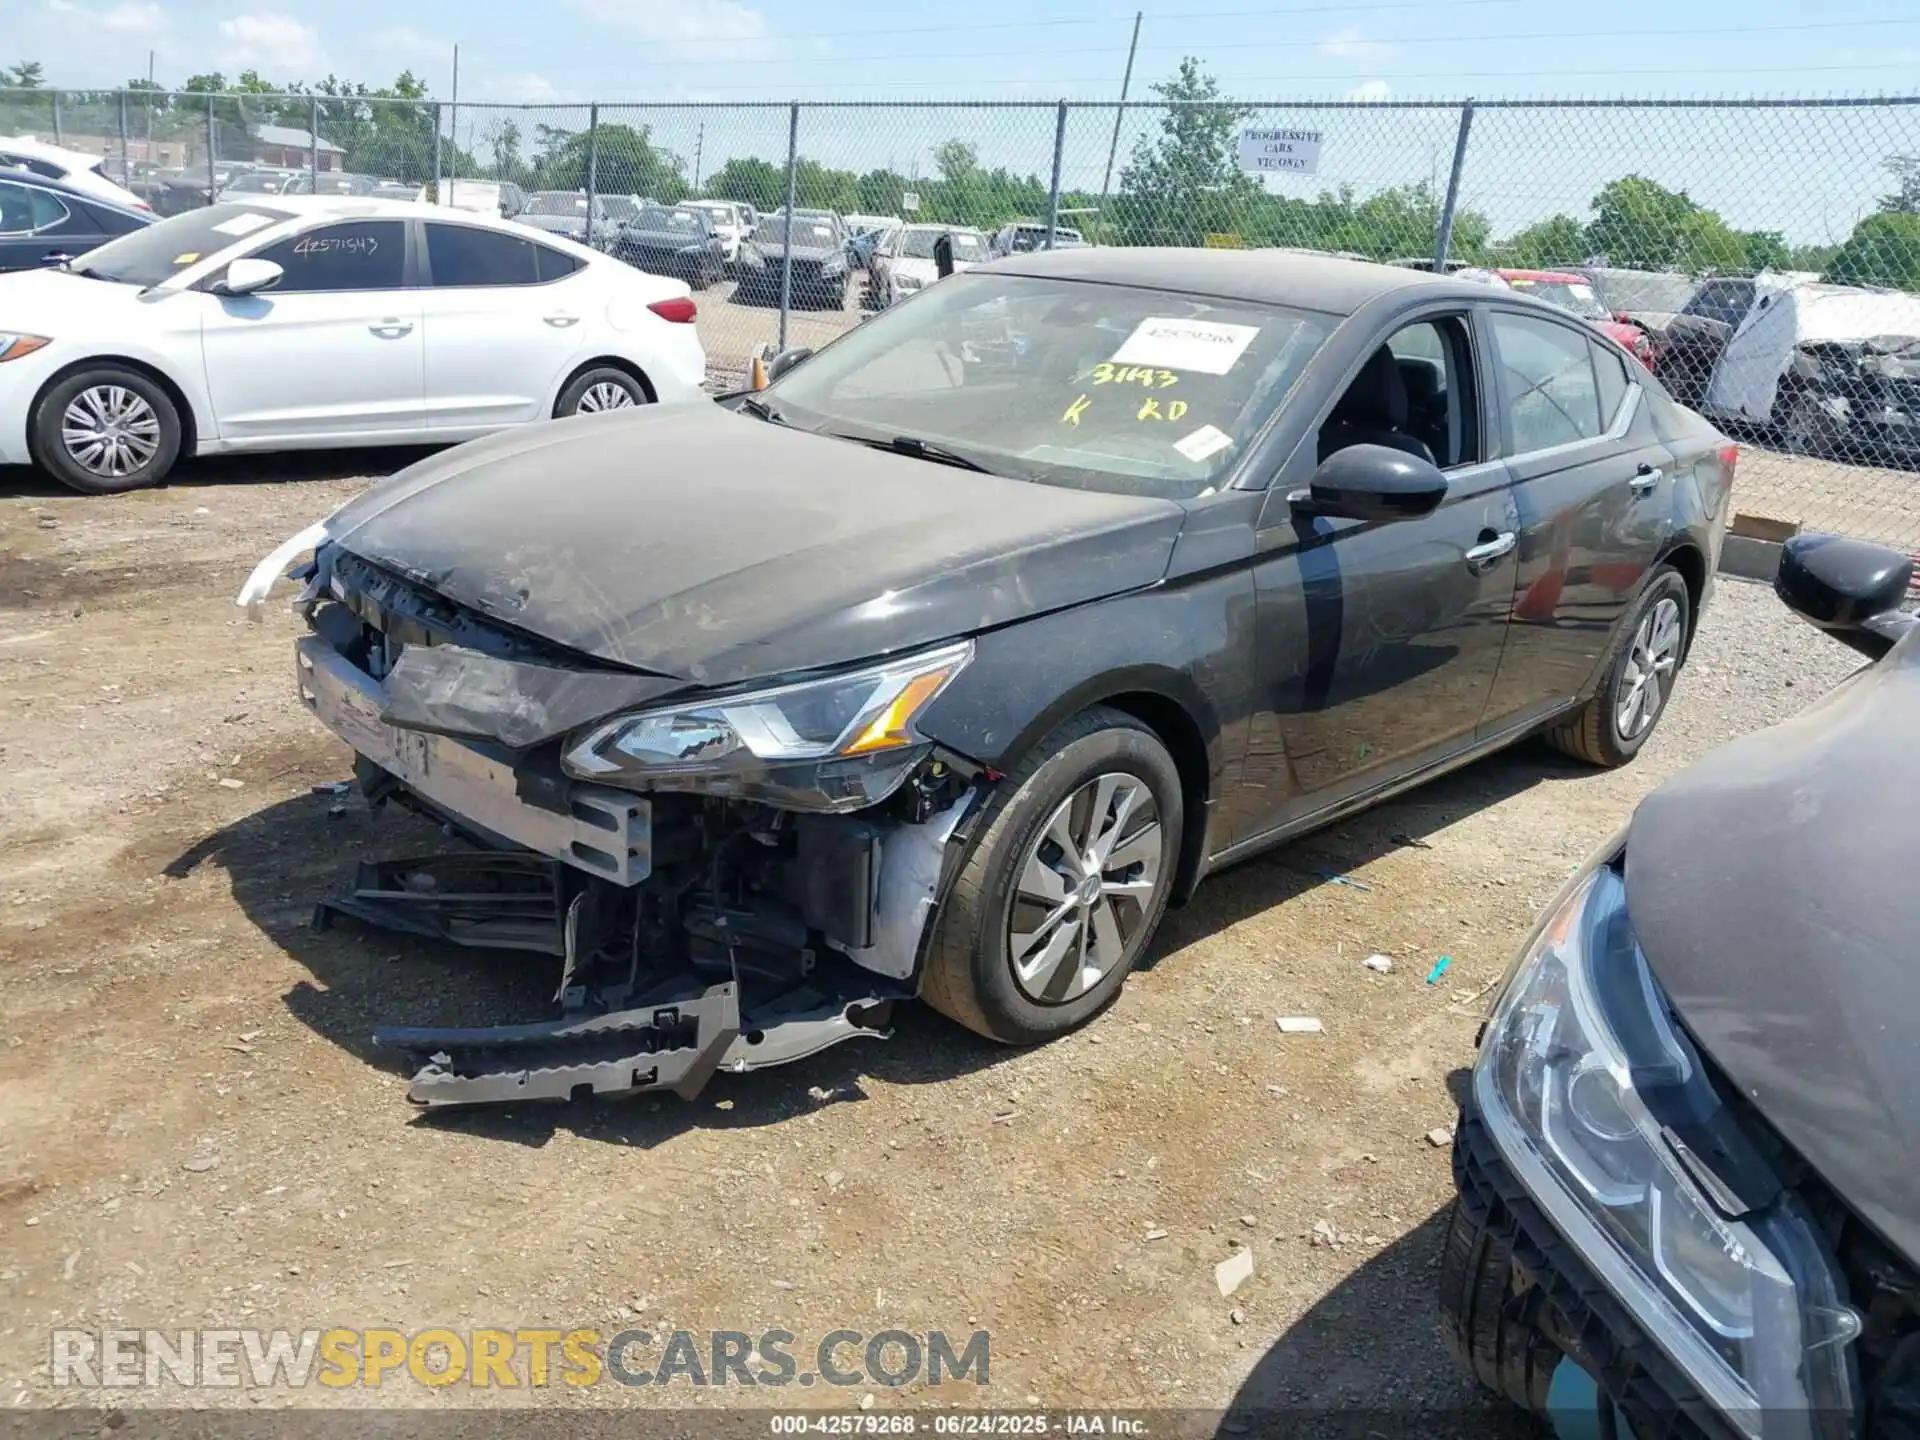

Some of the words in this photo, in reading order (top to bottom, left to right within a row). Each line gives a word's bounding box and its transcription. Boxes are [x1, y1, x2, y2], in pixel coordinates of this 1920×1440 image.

[1244, 130, 1323, 142] PROGRESSIVE
[1264, 143, 1293, 153] CARS
[1278, 158, 1307, 168] ONLY
[294, 236, 379, 260] 42571543
